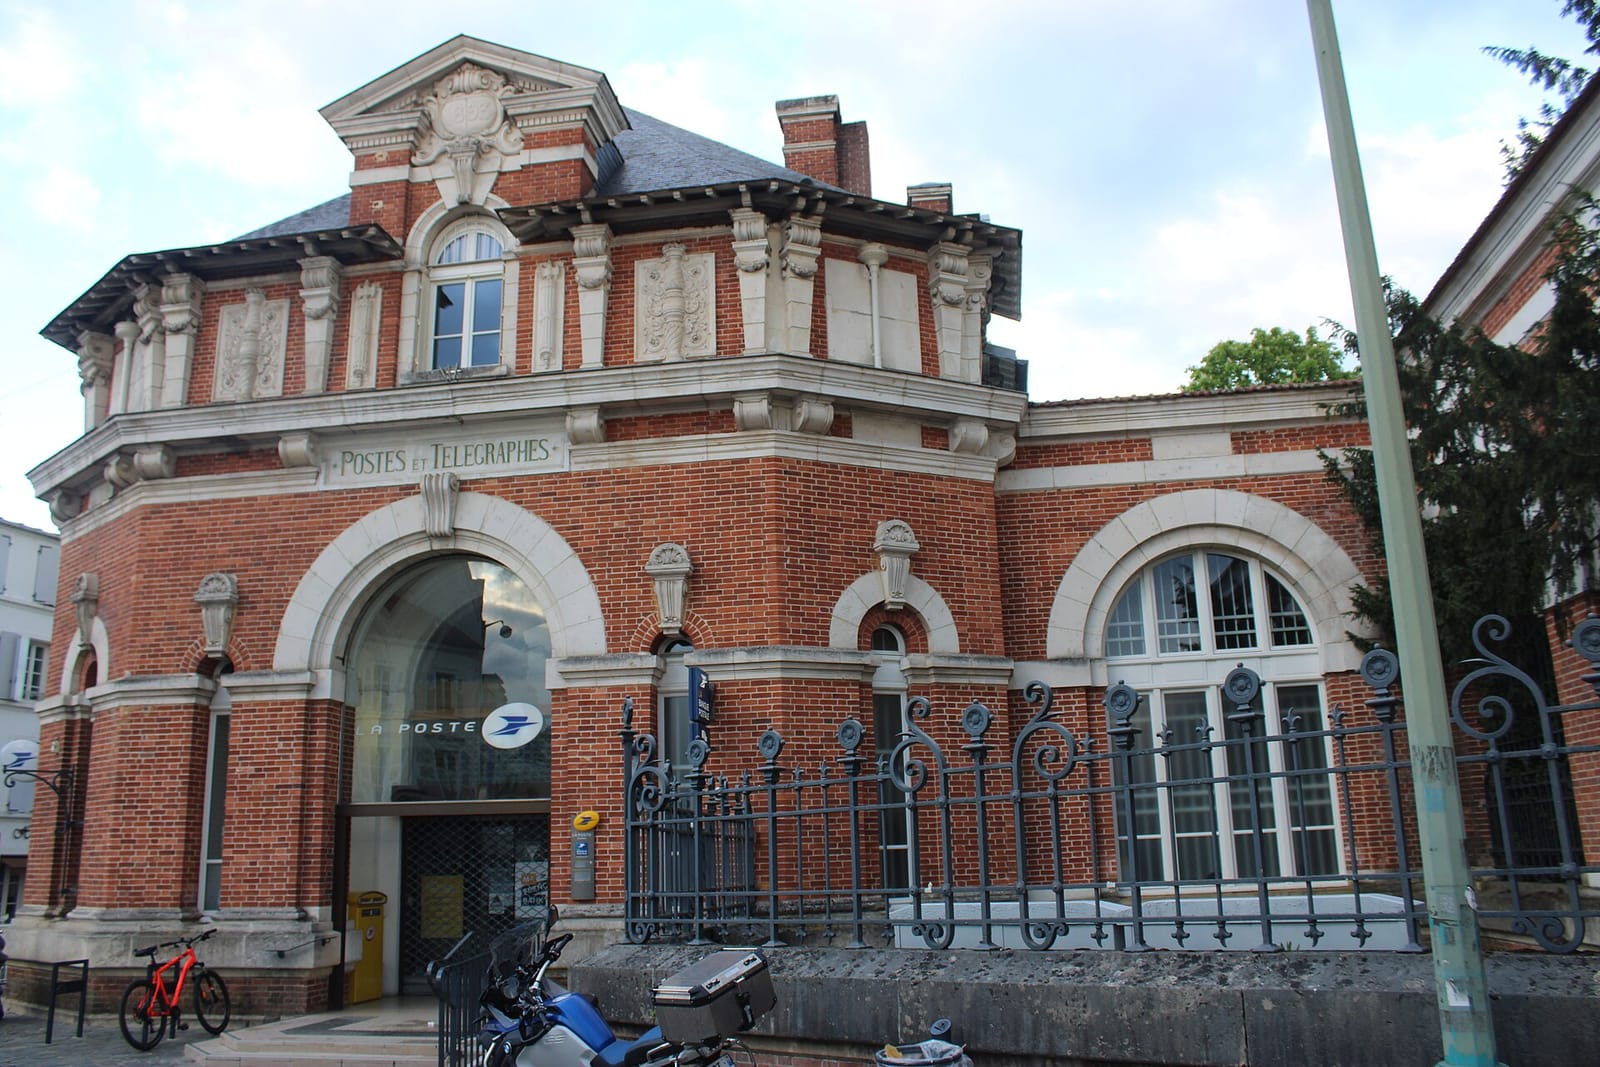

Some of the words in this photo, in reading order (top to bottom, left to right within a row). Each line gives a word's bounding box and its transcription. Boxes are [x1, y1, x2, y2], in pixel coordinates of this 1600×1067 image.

[340, 450, 406, 476] POSTES
[412, 457, 428, 472] ET
[431, 439, 549, 469] TELEGRAPHES
[355, 724, 383, 736] LA
[398, 721, 477, 734] POSTE
